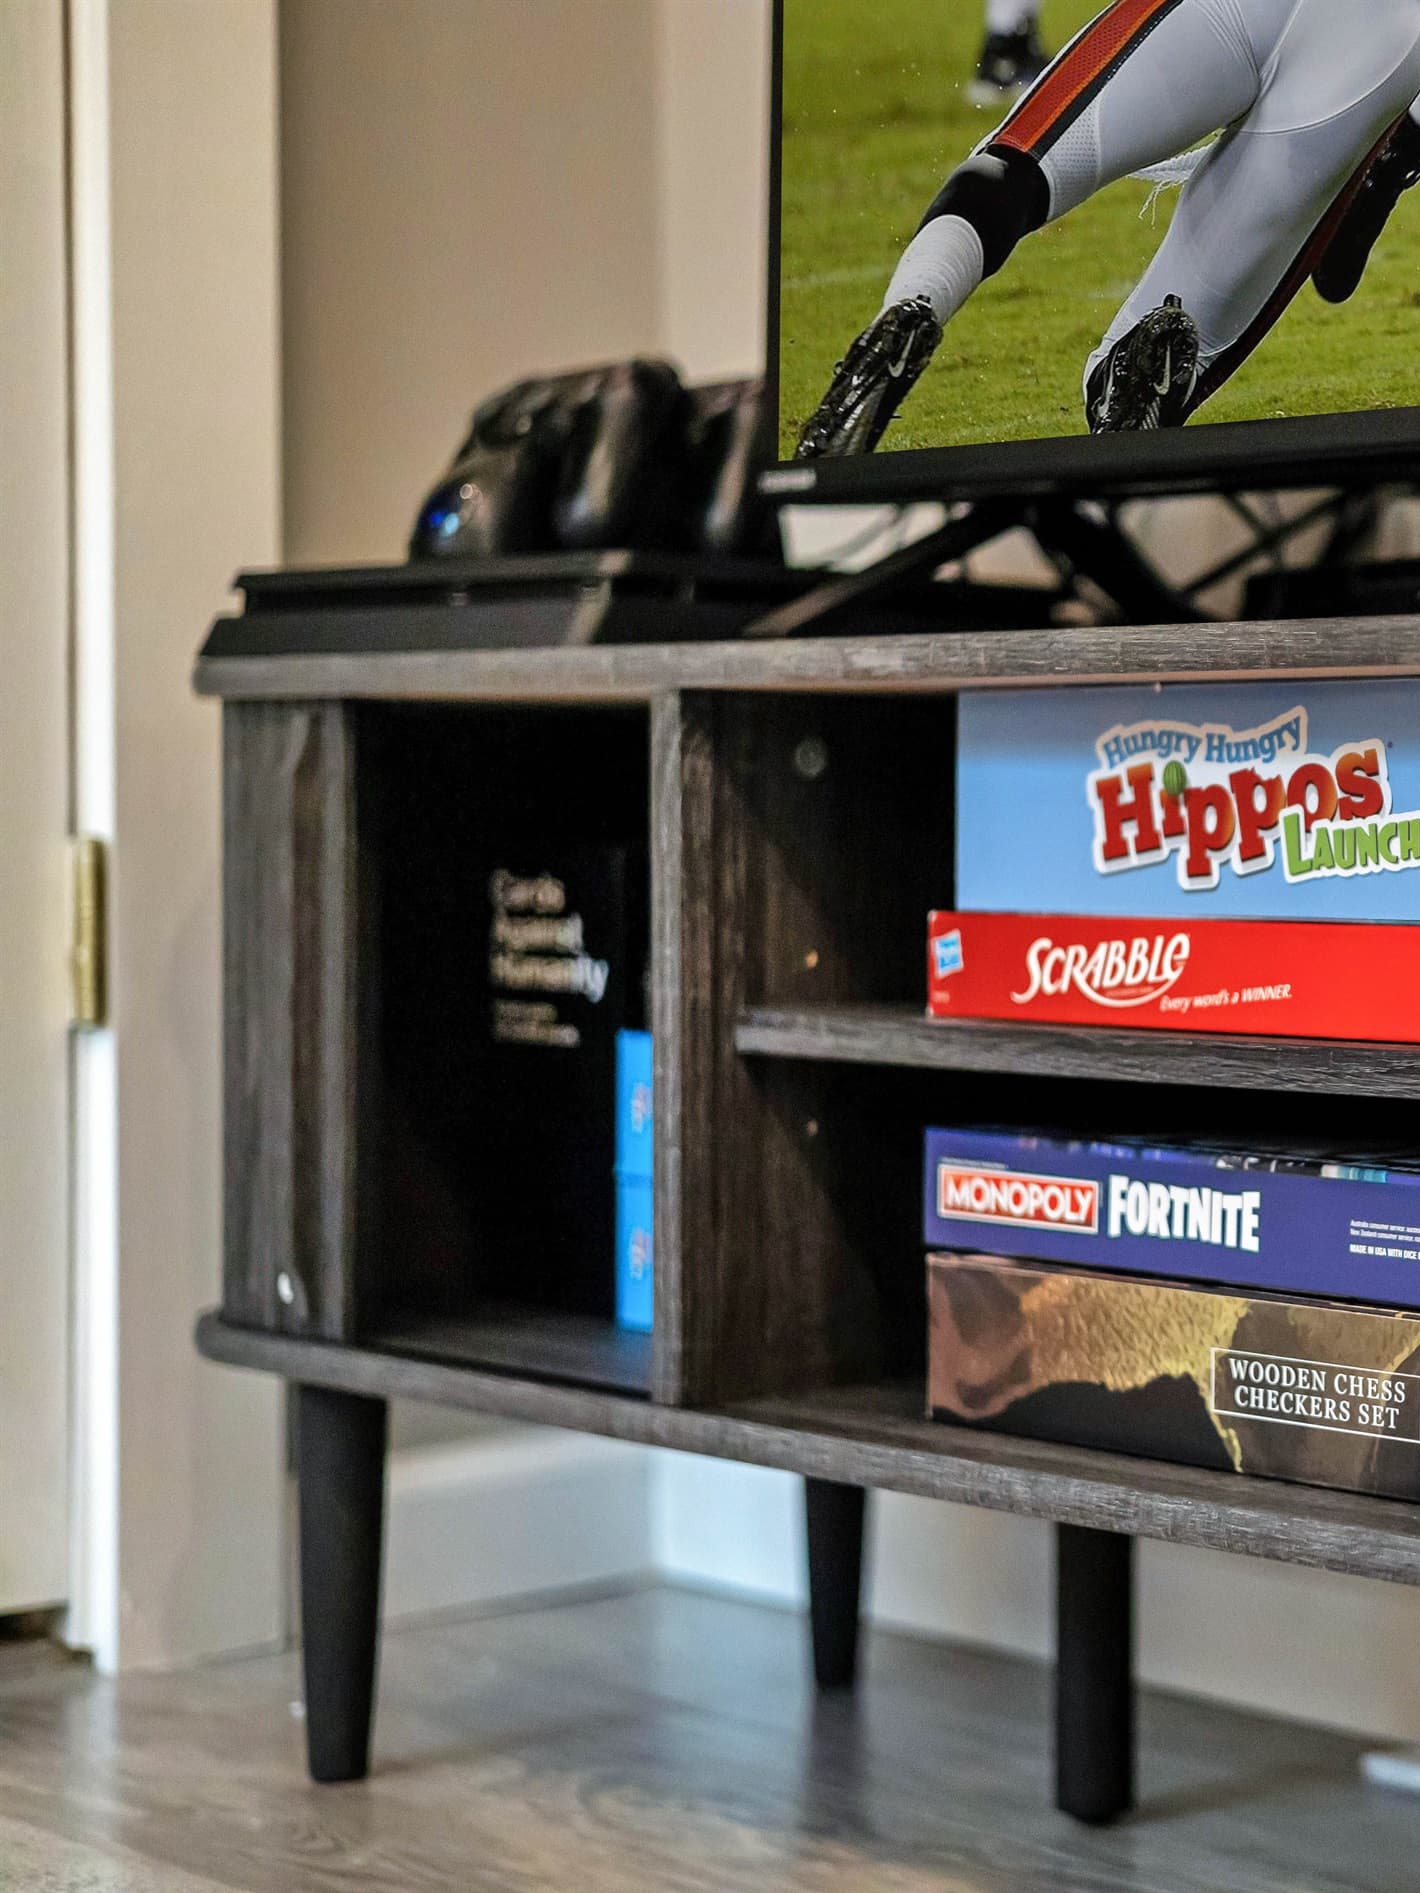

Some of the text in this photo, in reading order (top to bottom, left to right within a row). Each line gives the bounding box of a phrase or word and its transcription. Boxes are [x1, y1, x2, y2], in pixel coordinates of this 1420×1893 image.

[1103, 716, 1300, 769] Hungry Hungry
[1096, 748, 1384, 878] Hippos
[1010, 933, 1191, 1007] SCRABBLE
[1160, 996, 1190, 1013] Every
[1241, 983, 1293, 1003] WINNER.
[949, 1176, 1093, 1224] MONOPOLY
[1107, 1174, 1261, 1252] FORTNITE
[1349, 1243, 1367, 1254] MADE
[1367, 1245, 1374, 1255] IN
[1375, 1246, 1386, 1256] USA
[1387, 1248, 1402, 1258] WITH
[1403, 1250, 1417, 1260] DICE
[1228, 1357, 1406, 1403] WOODEN CHESS
[1234, 1385, 1400, 1429] CHECKERS SET
